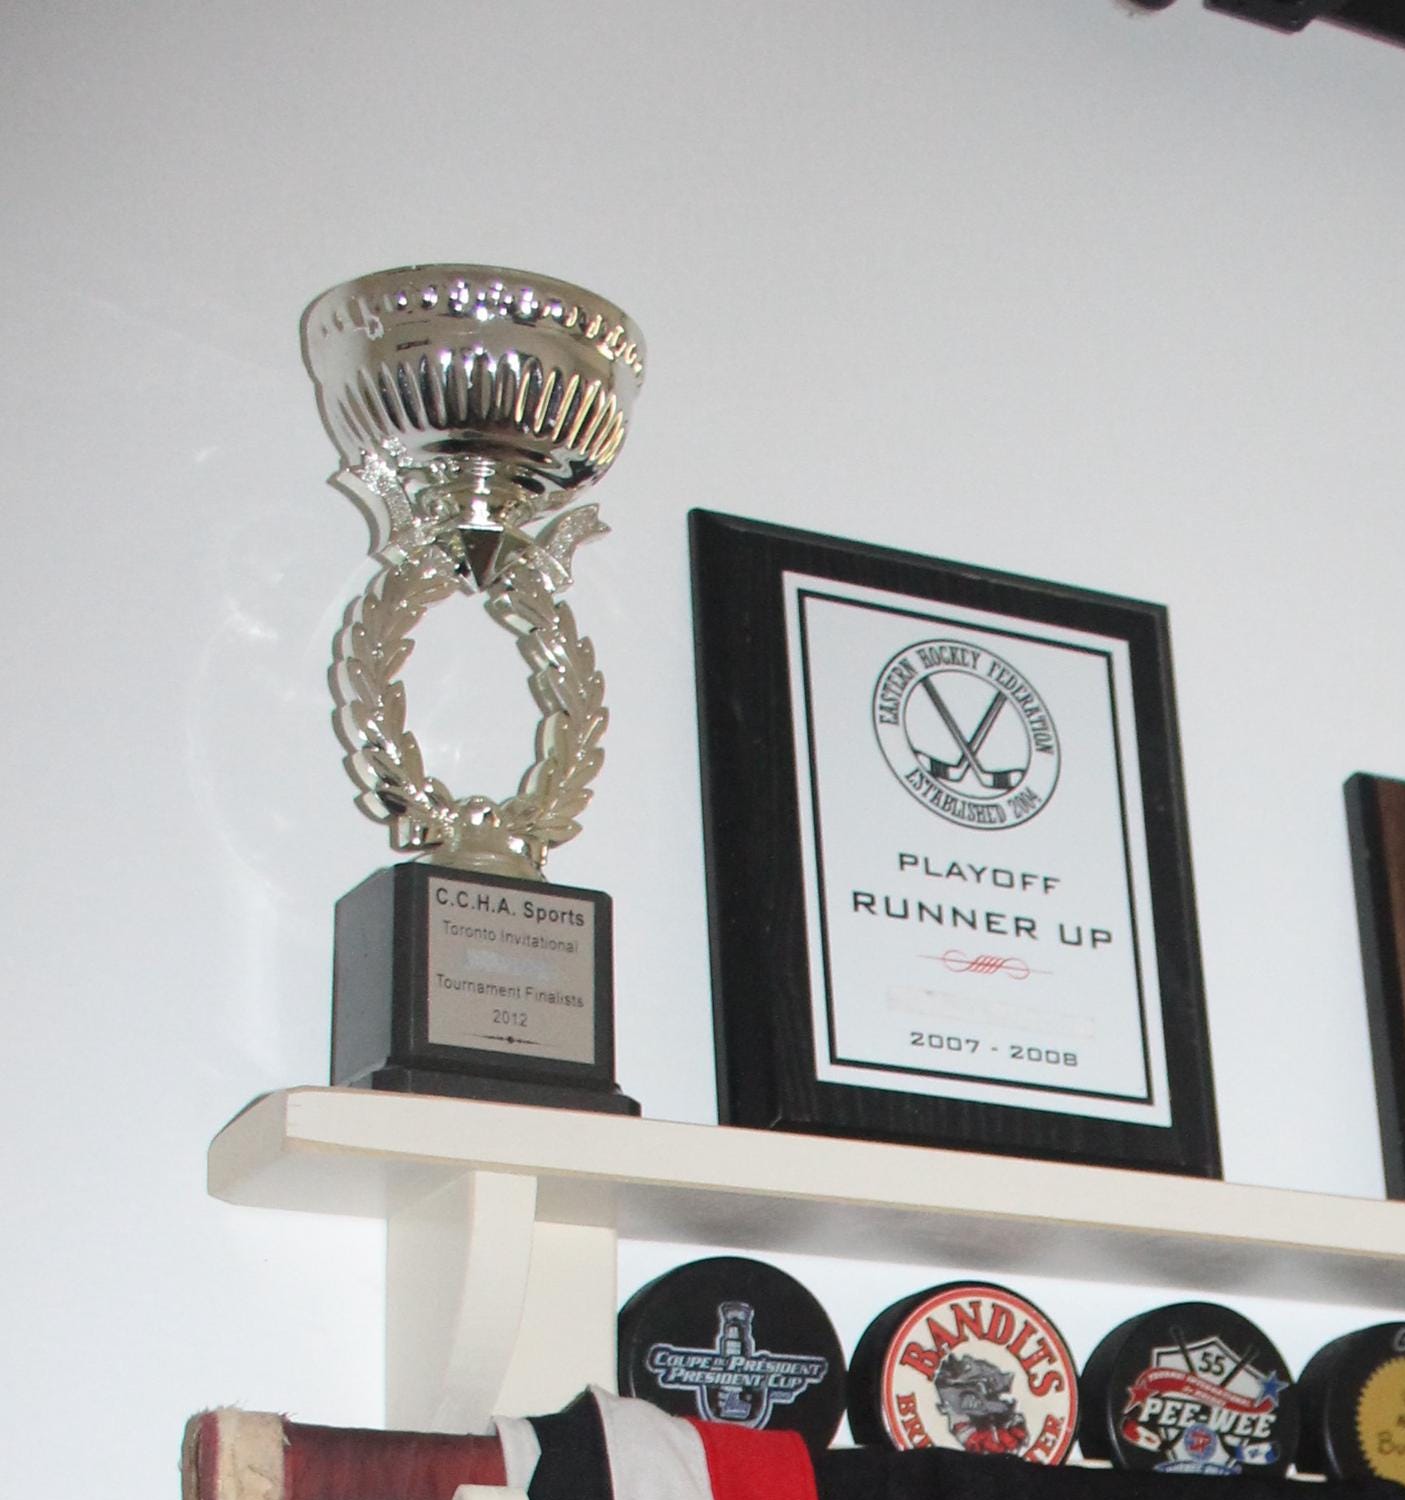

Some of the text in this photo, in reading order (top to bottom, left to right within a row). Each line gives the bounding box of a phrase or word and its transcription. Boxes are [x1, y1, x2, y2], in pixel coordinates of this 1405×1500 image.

[879, 645, 1054, 756] EASTERN HOCKEY FEDERATION
[905, 767, 1042, 824] ESTABLISHED 2004
[898, 851, 1061, 895] PLAYOFF
[436, 887, 585, 927] C.C.H.A. Sports
[852, 889, 1113, 950] RUNNER UP
[442, 919, 579, 954] Toronto Invitational
[436, 973, 585, 1009] Tournament Finalists
[493, 1009, 529, 1028] 2012
[910, 1031, 980, 1054] 2007
[1010, 1045, 1079, 1068] 2008
[901, 1300, 1065, 1398] BANDITS
[1198, 1350, 1226, 1379] 55
[1138, 1397, 1278, 1439] PEE-WEE
